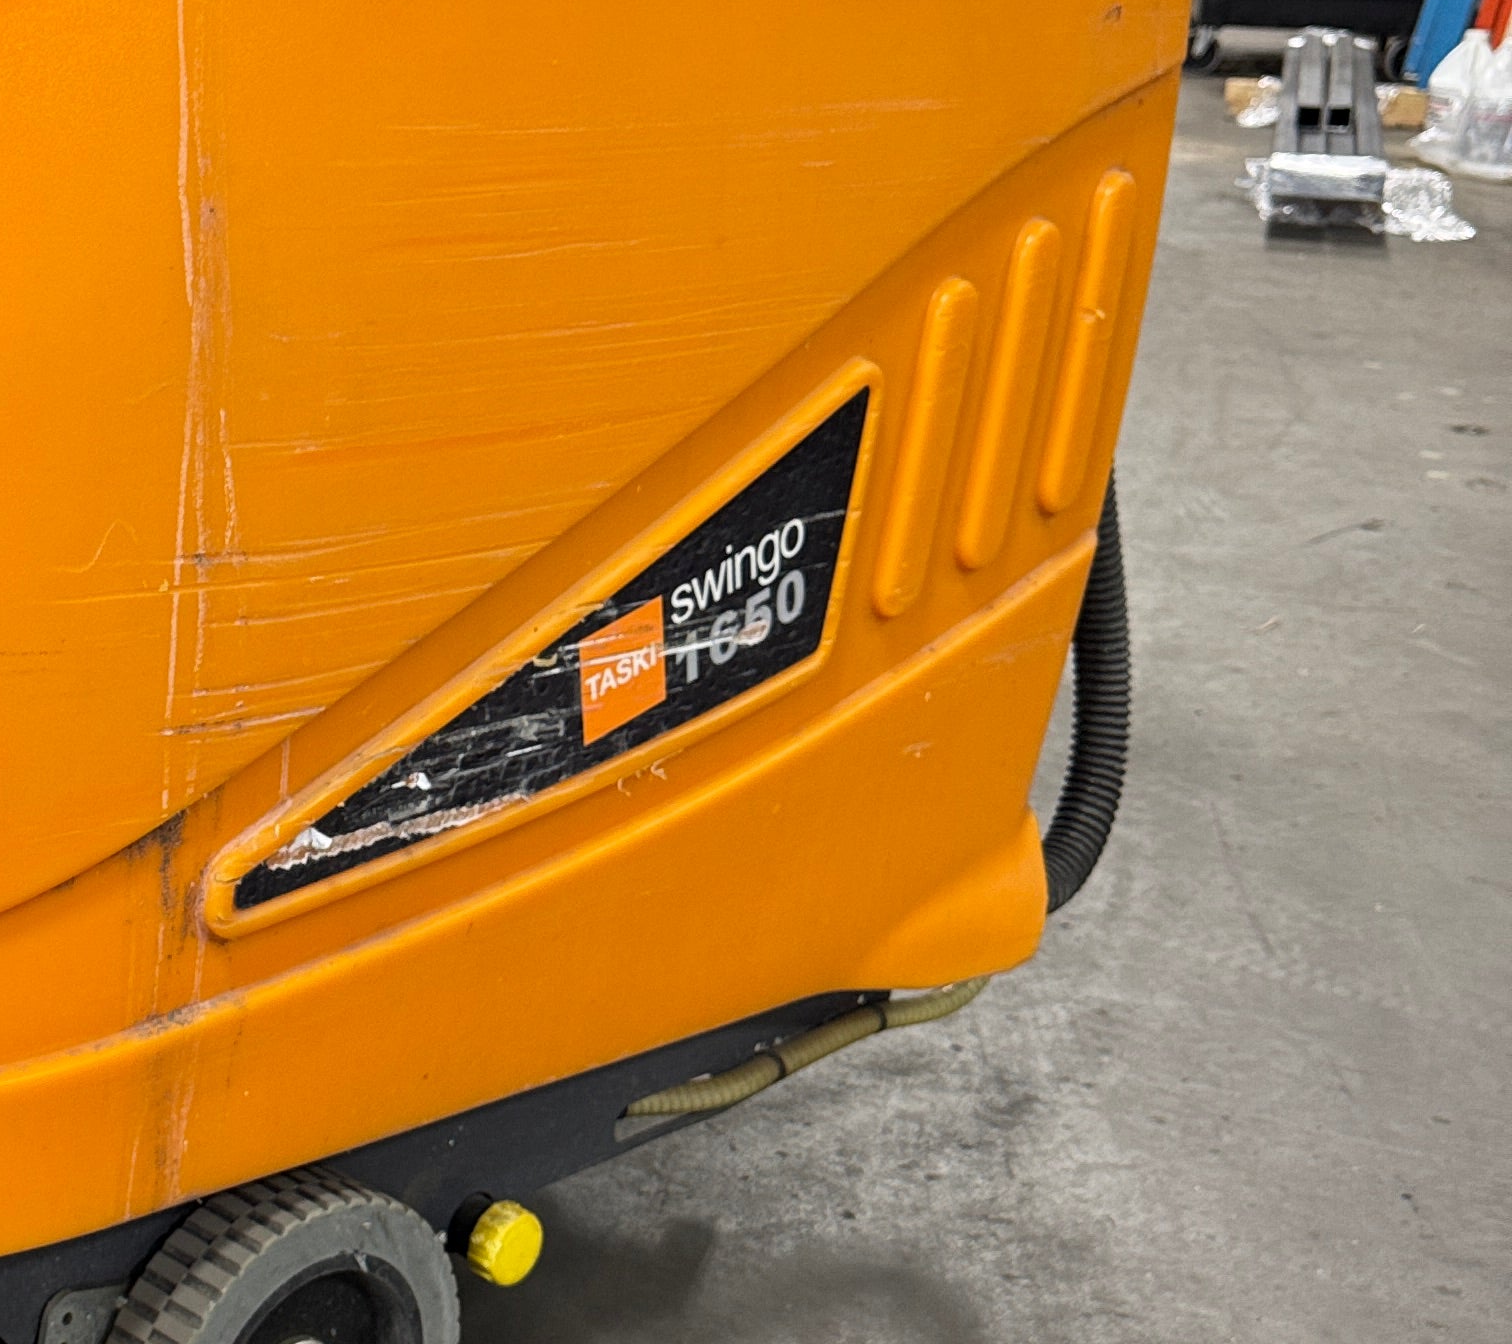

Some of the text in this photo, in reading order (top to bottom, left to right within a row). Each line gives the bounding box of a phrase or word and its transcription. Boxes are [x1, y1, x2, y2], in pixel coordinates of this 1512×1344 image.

[671, 518, 804, 624] swingo
[584, 643, 658, 701] TASKI
[675, 570, 805, 683] 1650
